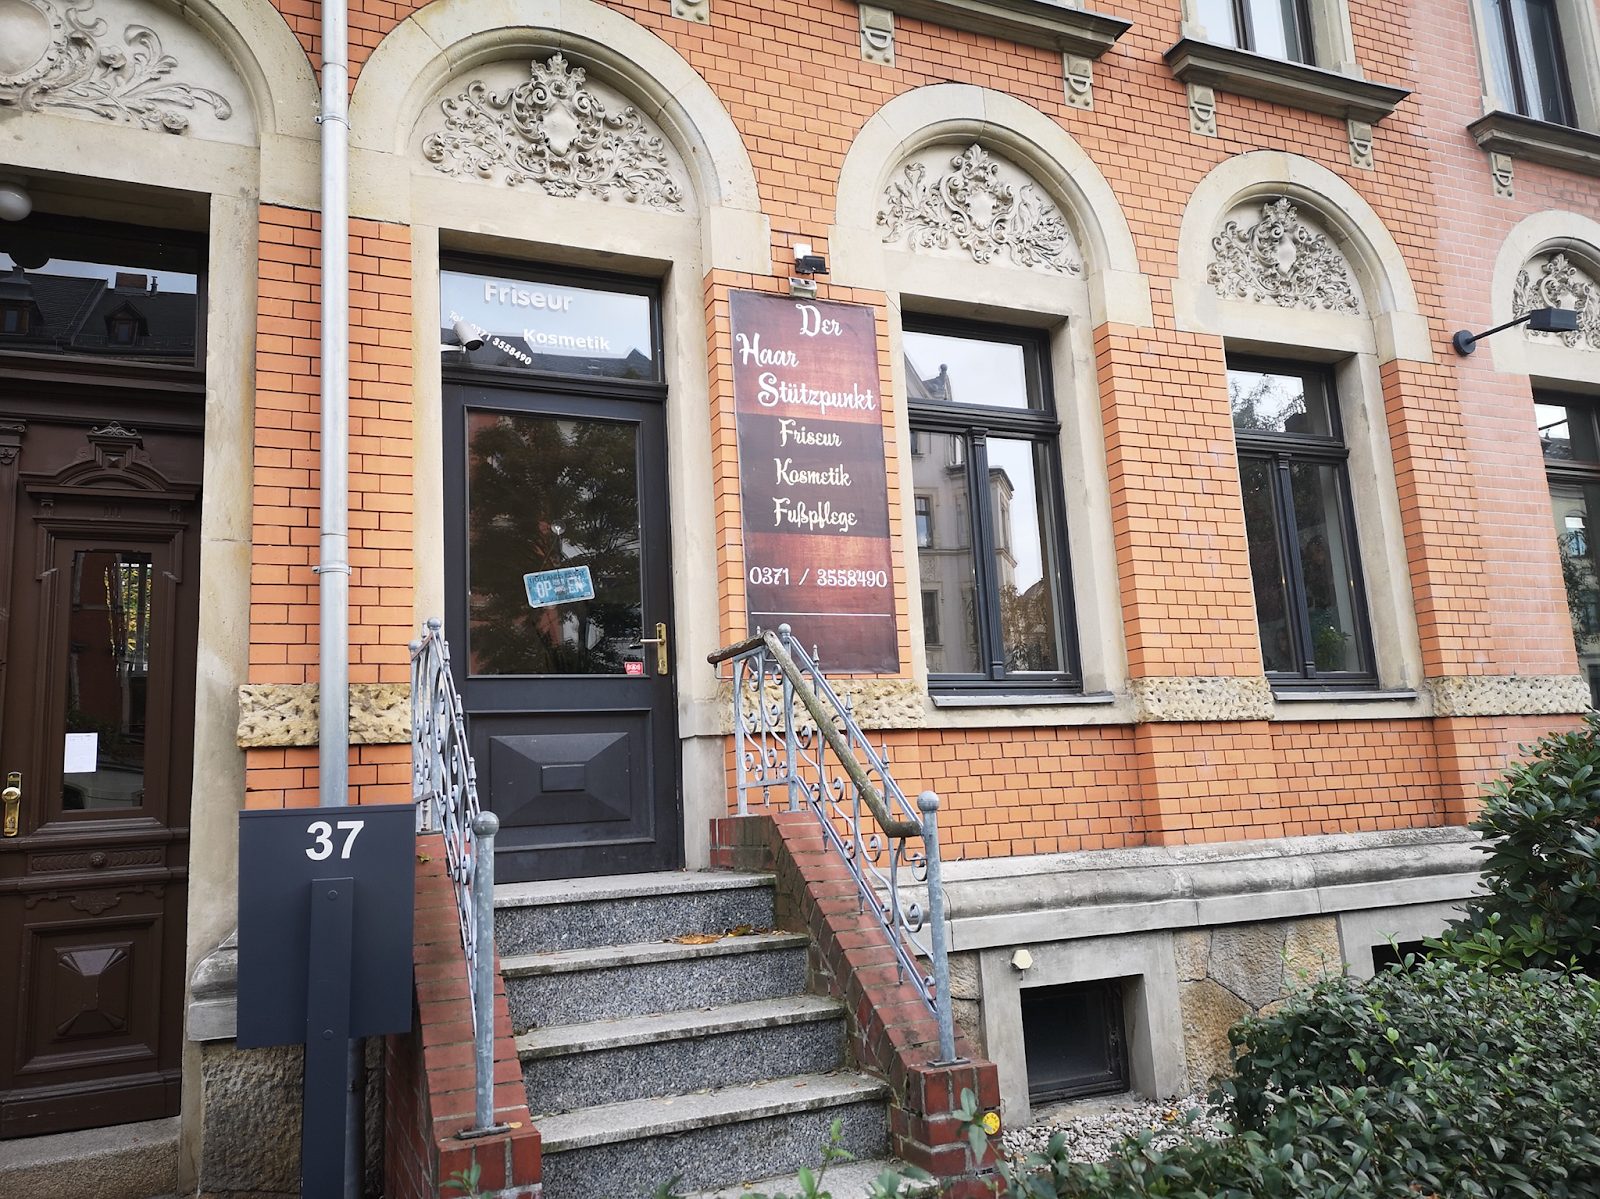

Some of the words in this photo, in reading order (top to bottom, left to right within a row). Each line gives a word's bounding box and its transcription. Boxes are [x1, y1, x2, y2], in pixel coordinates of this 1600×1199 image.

[484, 282, 573, 310] Friseur
[795, 304, 842, 337] Der
[492, 337, 532, 365] 3558490
[523, 328, 610, 351] Kosmetik
[735, 332, 800, 368] Haar
[758, 372, 876, 414] Stützpunkt
[778, 418, 842, 448] Friseur
[773, 457, 851, 487] Kosmetik
[772, 497, 858, 532] Fußpflege
[749, 566, 790, 586] 0371
[798, 568, 810, 586] /
[816, 568, 888, 588] 3558490
[305, 820, 365, 861] 37
